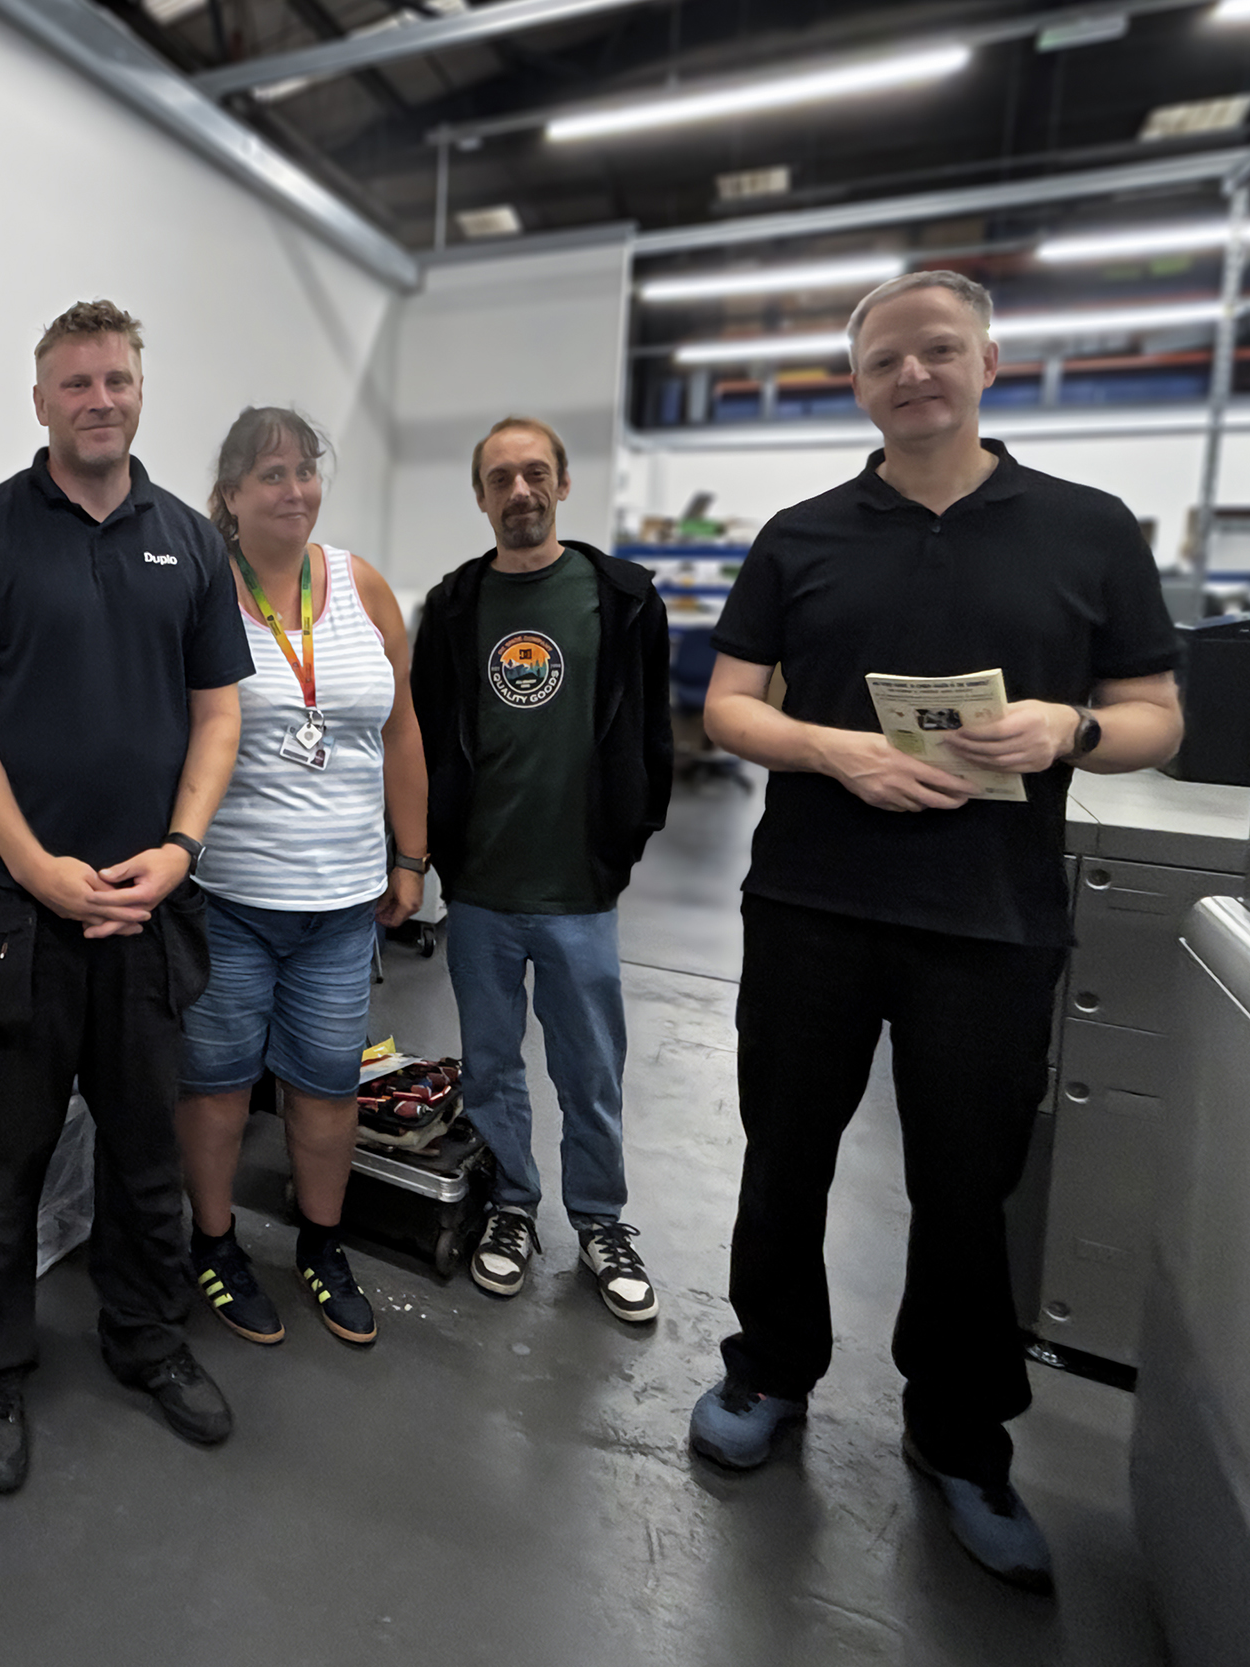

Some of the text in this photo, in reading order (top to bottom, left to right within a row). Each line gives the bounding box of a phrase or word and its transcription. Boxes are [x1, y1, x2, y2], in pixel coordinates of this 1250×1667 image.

[143, 551, 178, 566] Duplo
[493, 670, 559, 704] QUALITY GOODS
